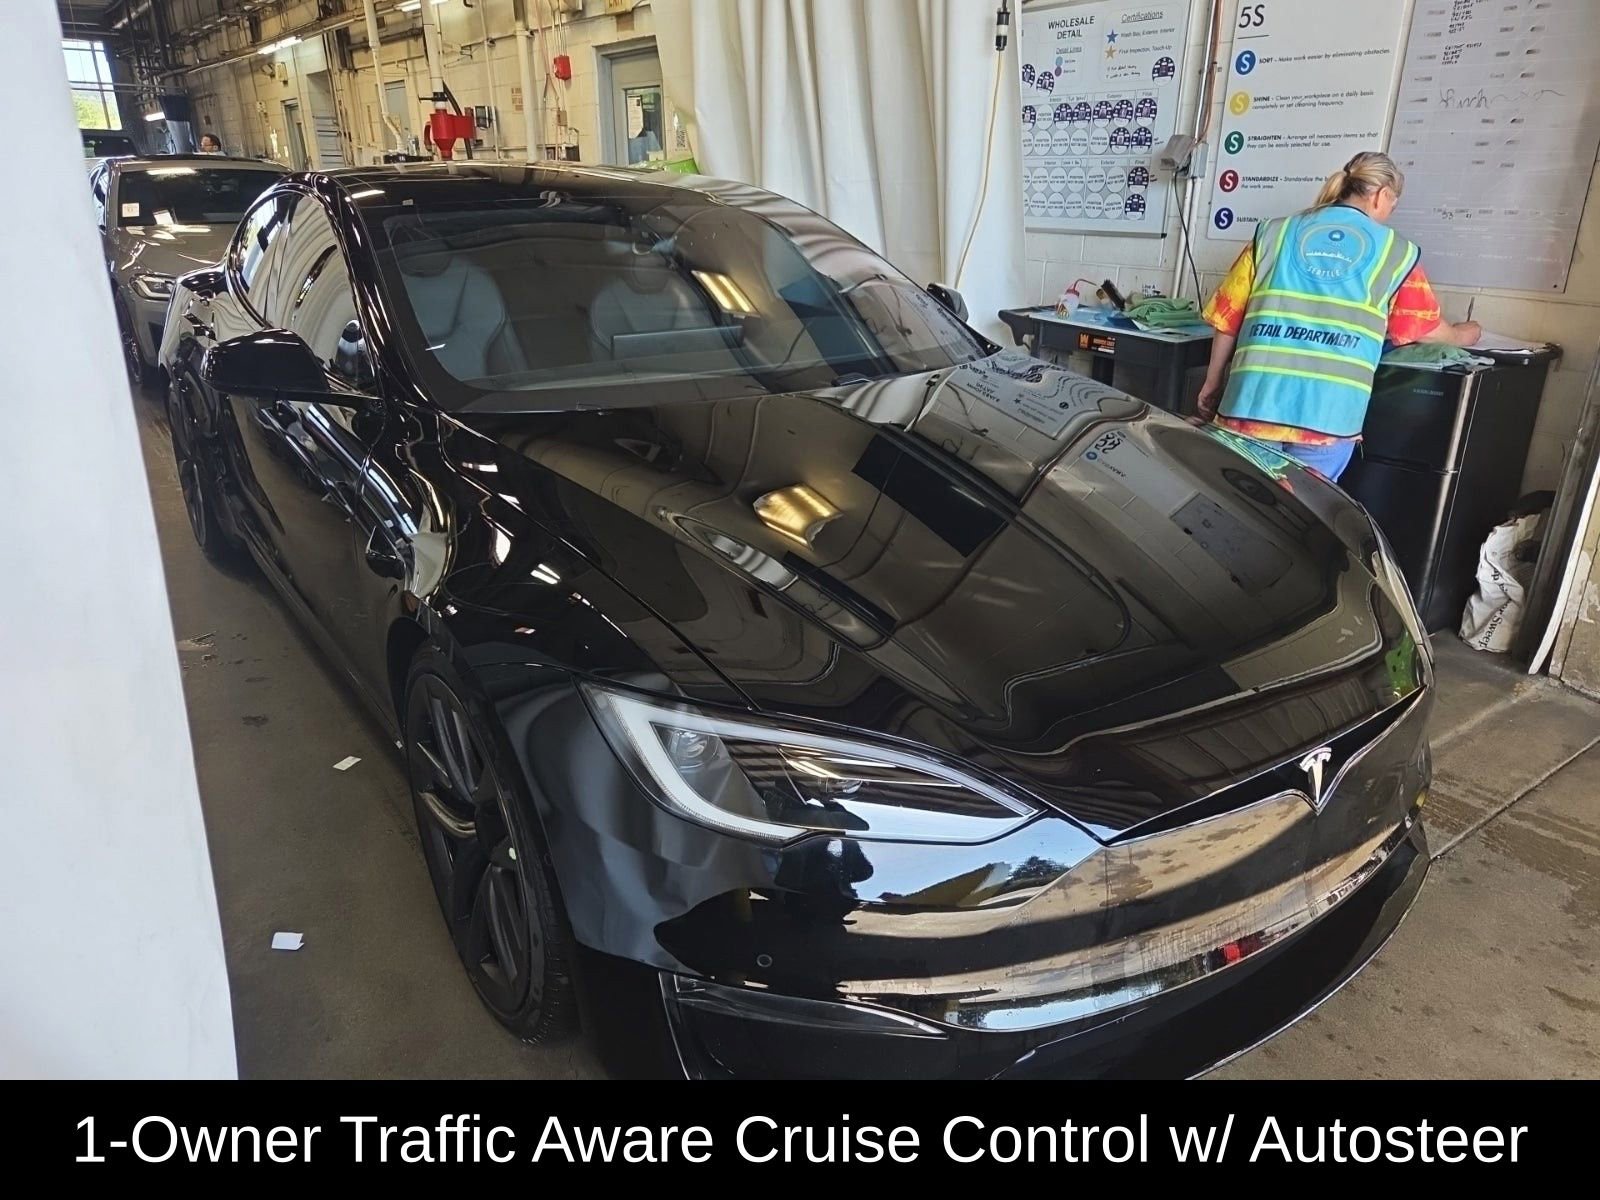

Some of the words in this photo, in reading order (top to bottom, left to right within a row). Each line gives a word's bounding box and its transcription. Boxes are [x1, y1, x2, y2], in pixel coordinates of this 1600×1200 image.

[1048, 15, 1096, 30] WHOLESALE
[1120, 10, 1164, 23] Certifications
[1238, 4, 1266, 29] 5S
[1056, 30, 1083, 40] DETAIL
[1346, 90, 1358, 98] daily
[1284, 326, 1361, 349] DEPARTMENT
